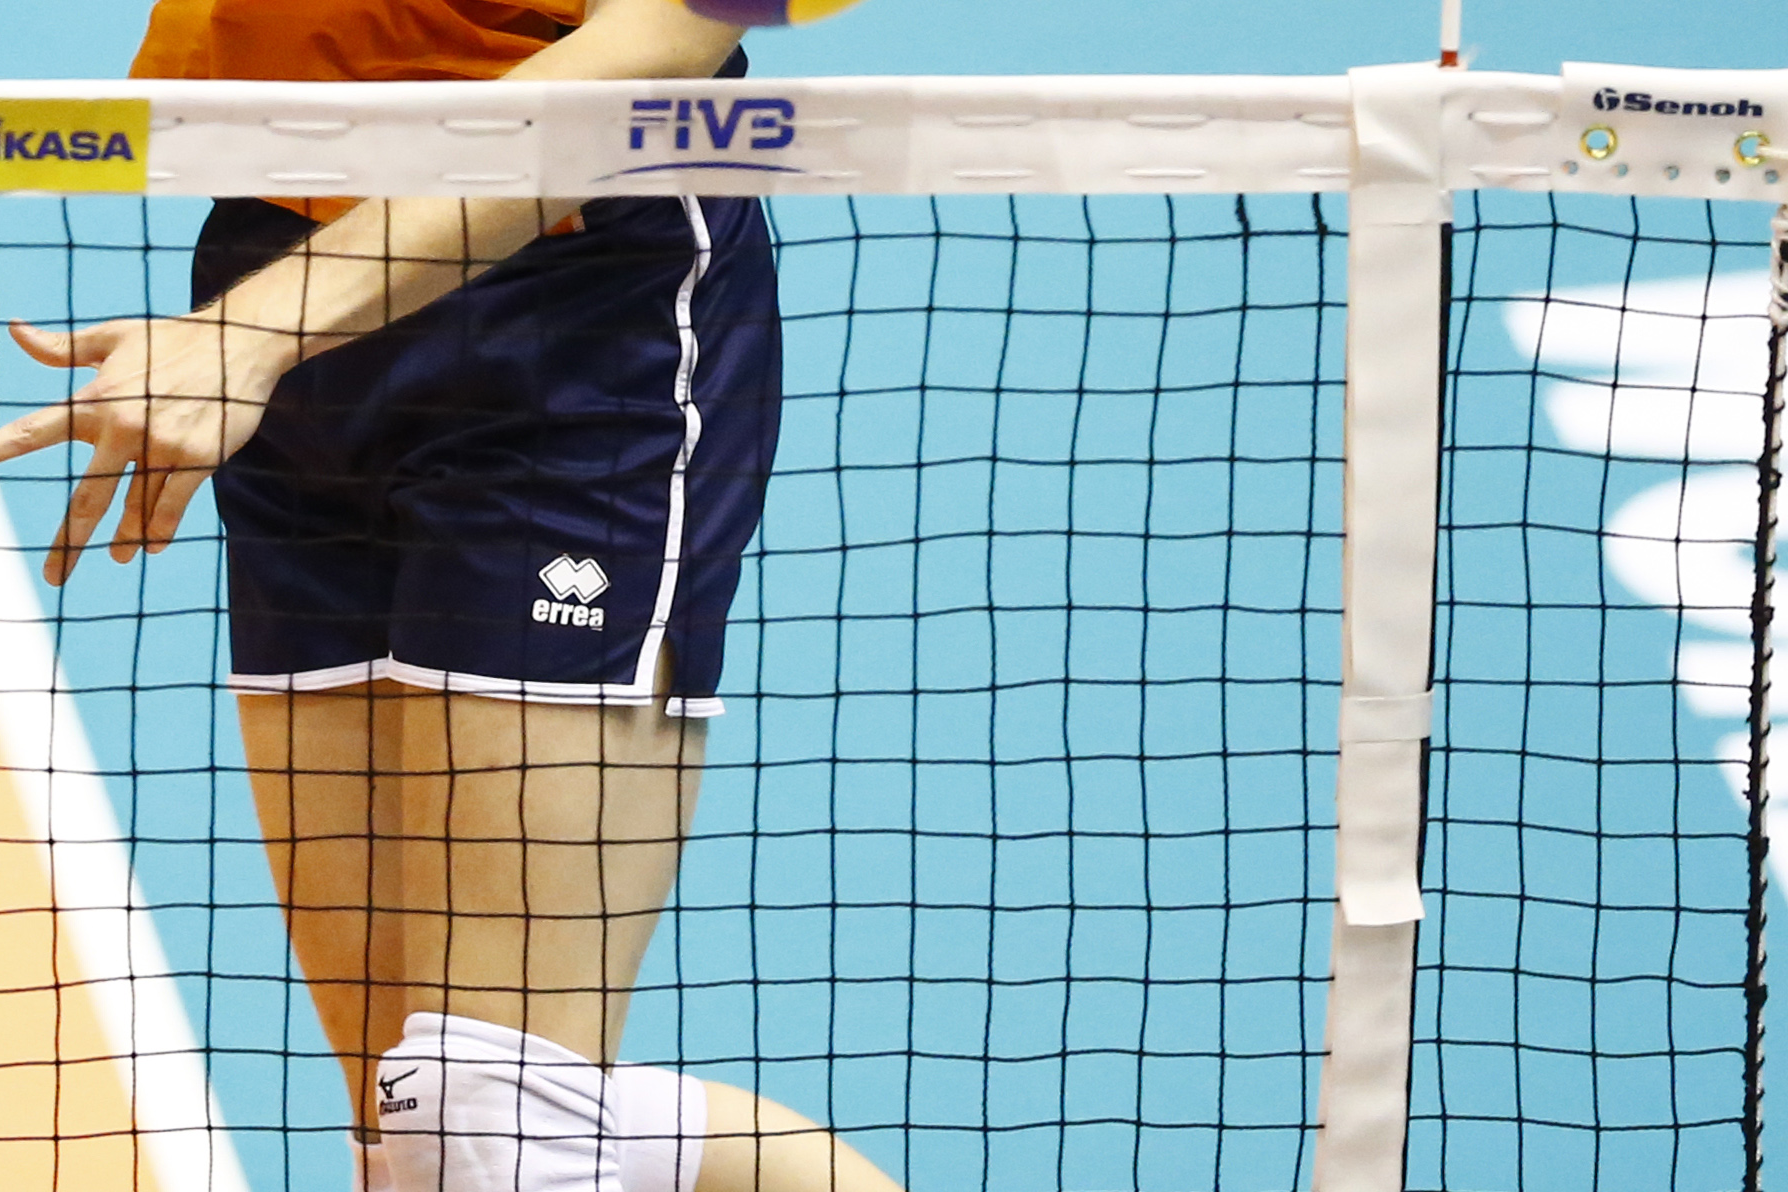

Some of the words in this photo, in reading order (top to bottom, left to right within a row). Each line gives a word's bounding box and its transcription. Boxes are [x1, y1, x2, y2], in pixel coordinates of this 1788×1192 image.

[1623, 92, 1764, 117] Senoh
[629, 99, 796, 150] FIVB
[532, 598, 605, 631] errea
